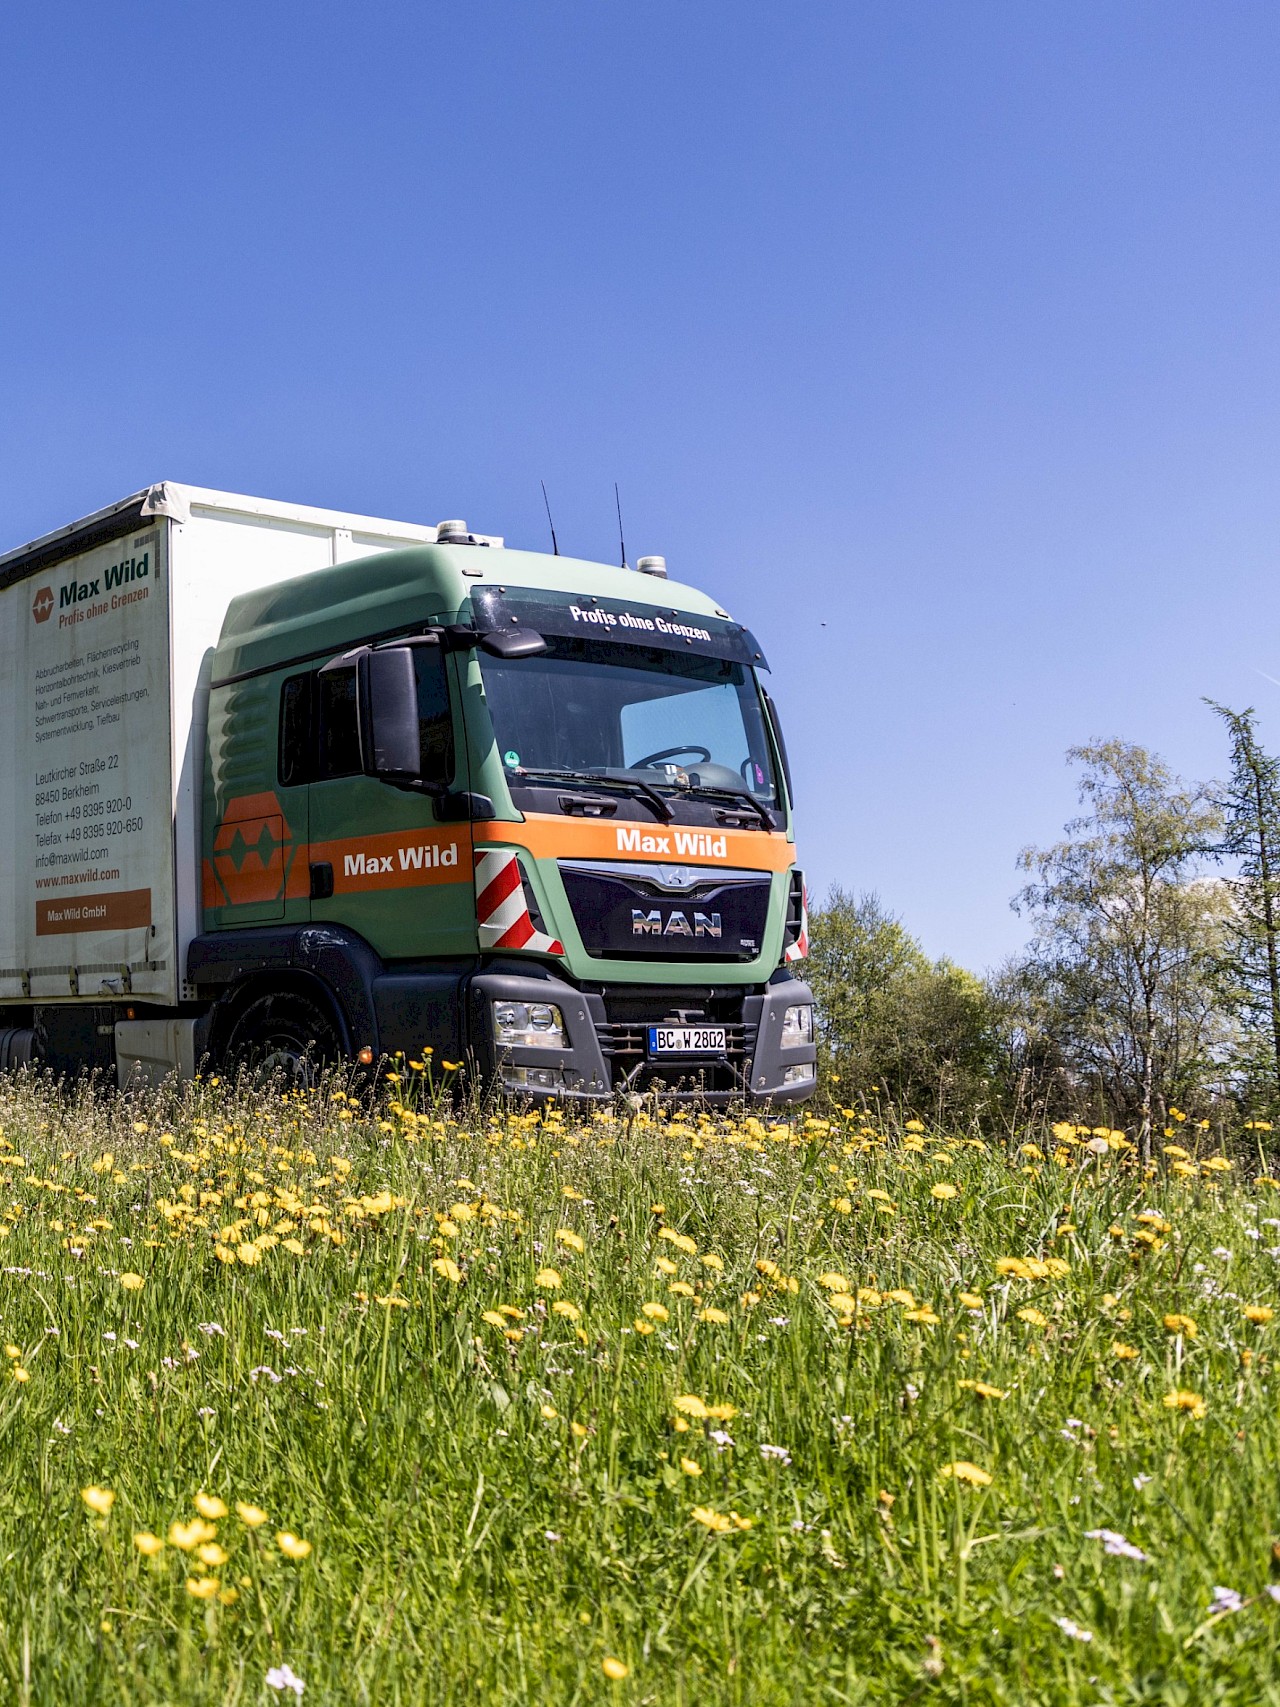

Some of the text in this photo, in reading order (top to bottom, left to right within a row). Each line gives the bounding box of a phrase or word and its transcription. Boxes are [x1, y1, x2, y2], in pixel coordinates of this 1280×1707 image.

[60, 553, 148, 608] Max Wild
[59, 587, 148, 629] Profis ohne Grenzen
[569, 605, 711, 641] Profis ohne Grenzen
[87, 640, 139, 664] Flächenrecycling
[102, 654, 140, 675] Kiesvertrieb
[50, 695, 61, 707] und
[91, 688, 149, 711] Serviceleistungen,
[97, 712, 120, 726] Tiefbau
[36, 754, 119, 786] Leutkircher Straße 22
[35, 782, 99, 806] 88450 Berkheim
[36, 797, 132, 827] Telefon +49 8395 920-0
[36, 817, 143, 847] Telefax +49 8395 920-650
[616, 828, 727, 858] Max Wild
[36, 847, 108, 868] info@maxwild.com
[343, 843, 458, 877] Max Wild
[36, 868, 120, 888] www.maxwild.com
[47, 905, 106, 922] Max Wild GmbH
[631, 908, 722, 938] MAN
[657, 1031, 724, 1048] BC W 2802
